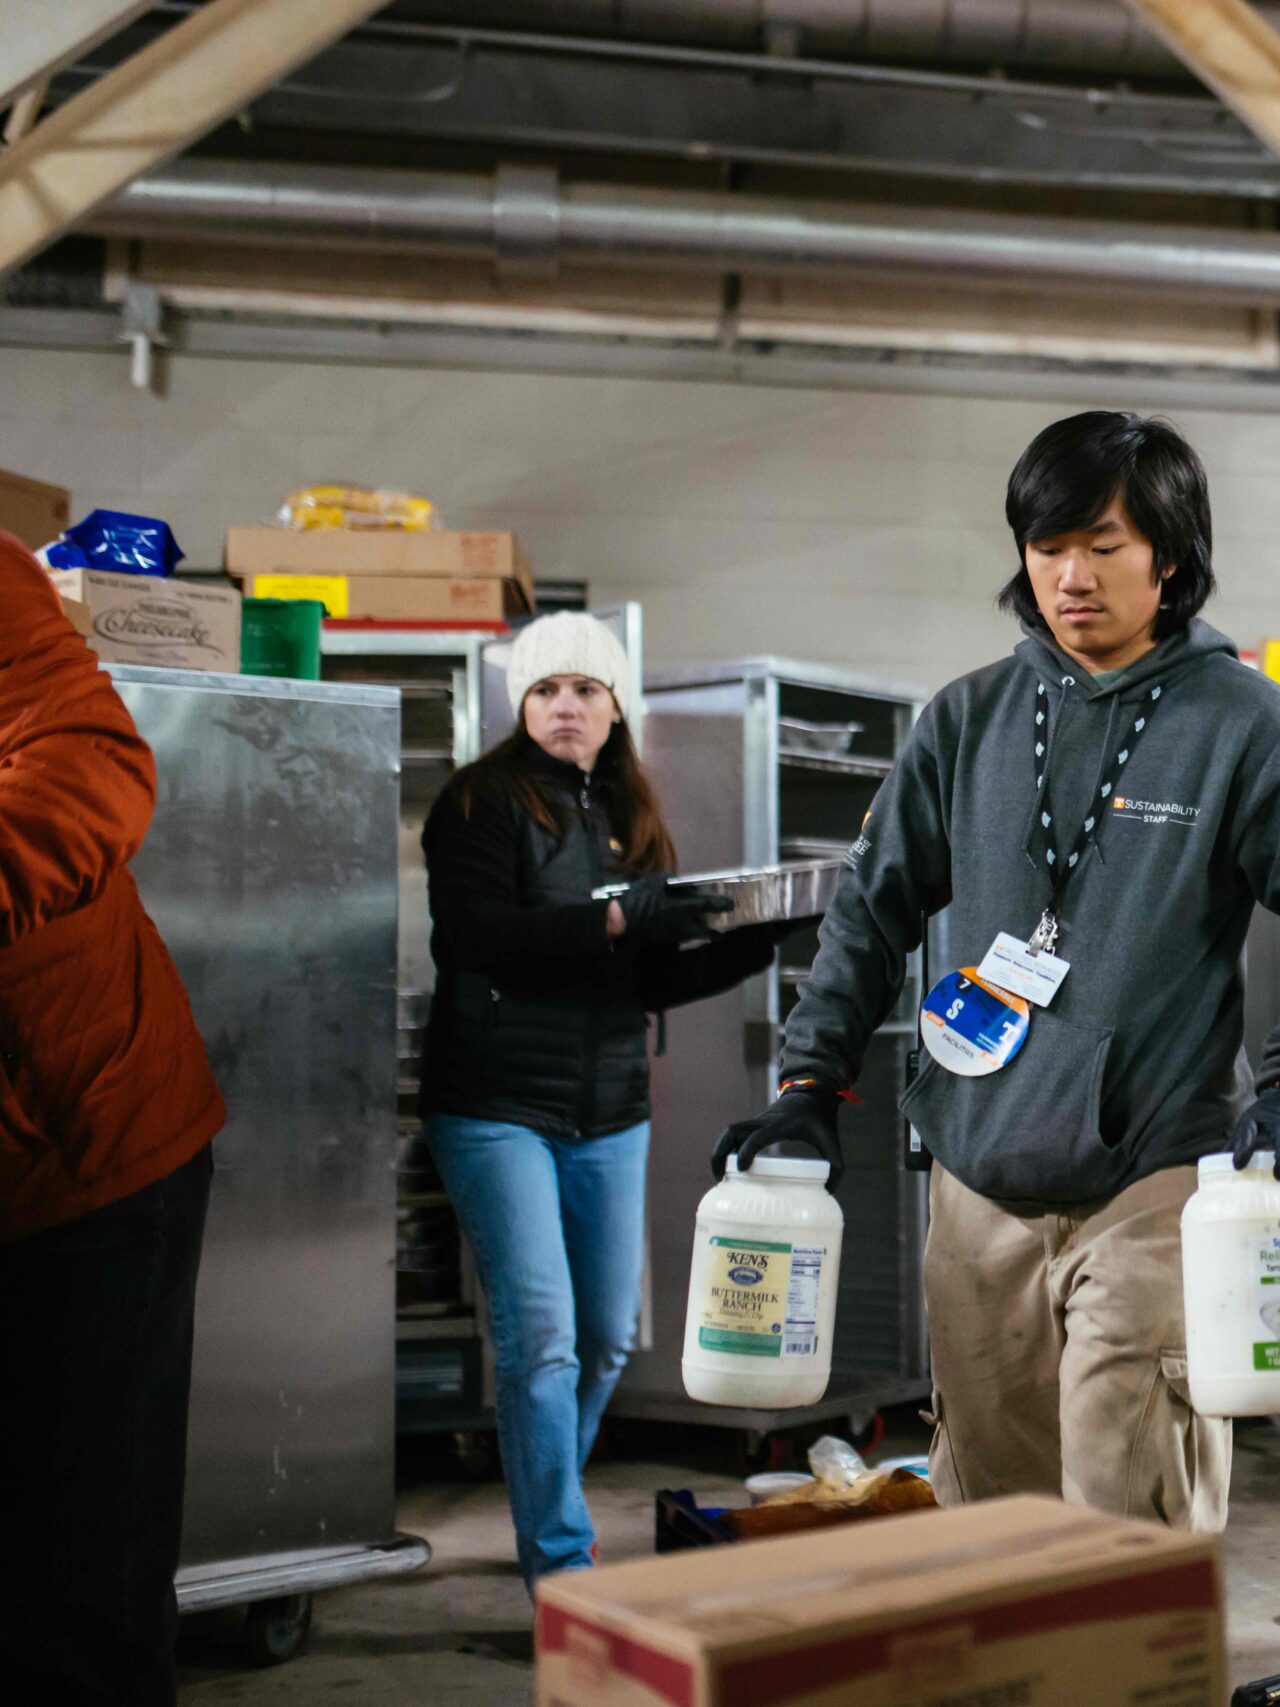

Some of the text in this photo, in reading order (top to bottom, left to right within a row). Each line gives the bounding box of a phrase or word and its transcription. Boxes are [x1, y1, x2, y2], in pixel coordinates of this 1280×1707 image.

[104, 608, 209, 644] Cheesecake
[1125, 799, 1200, 816] SUSTAINABILITY
[1143, 814, 1168, 824] STAFF
[959, 977, 972, 990] 7
[945, 998, 965, 1021] S
[942, 1032, 975, 1059] FACILITIES
[711, 1287, 779, 1303] BUTTERMILK
[723, 1300, 762, 1312] RANCH
